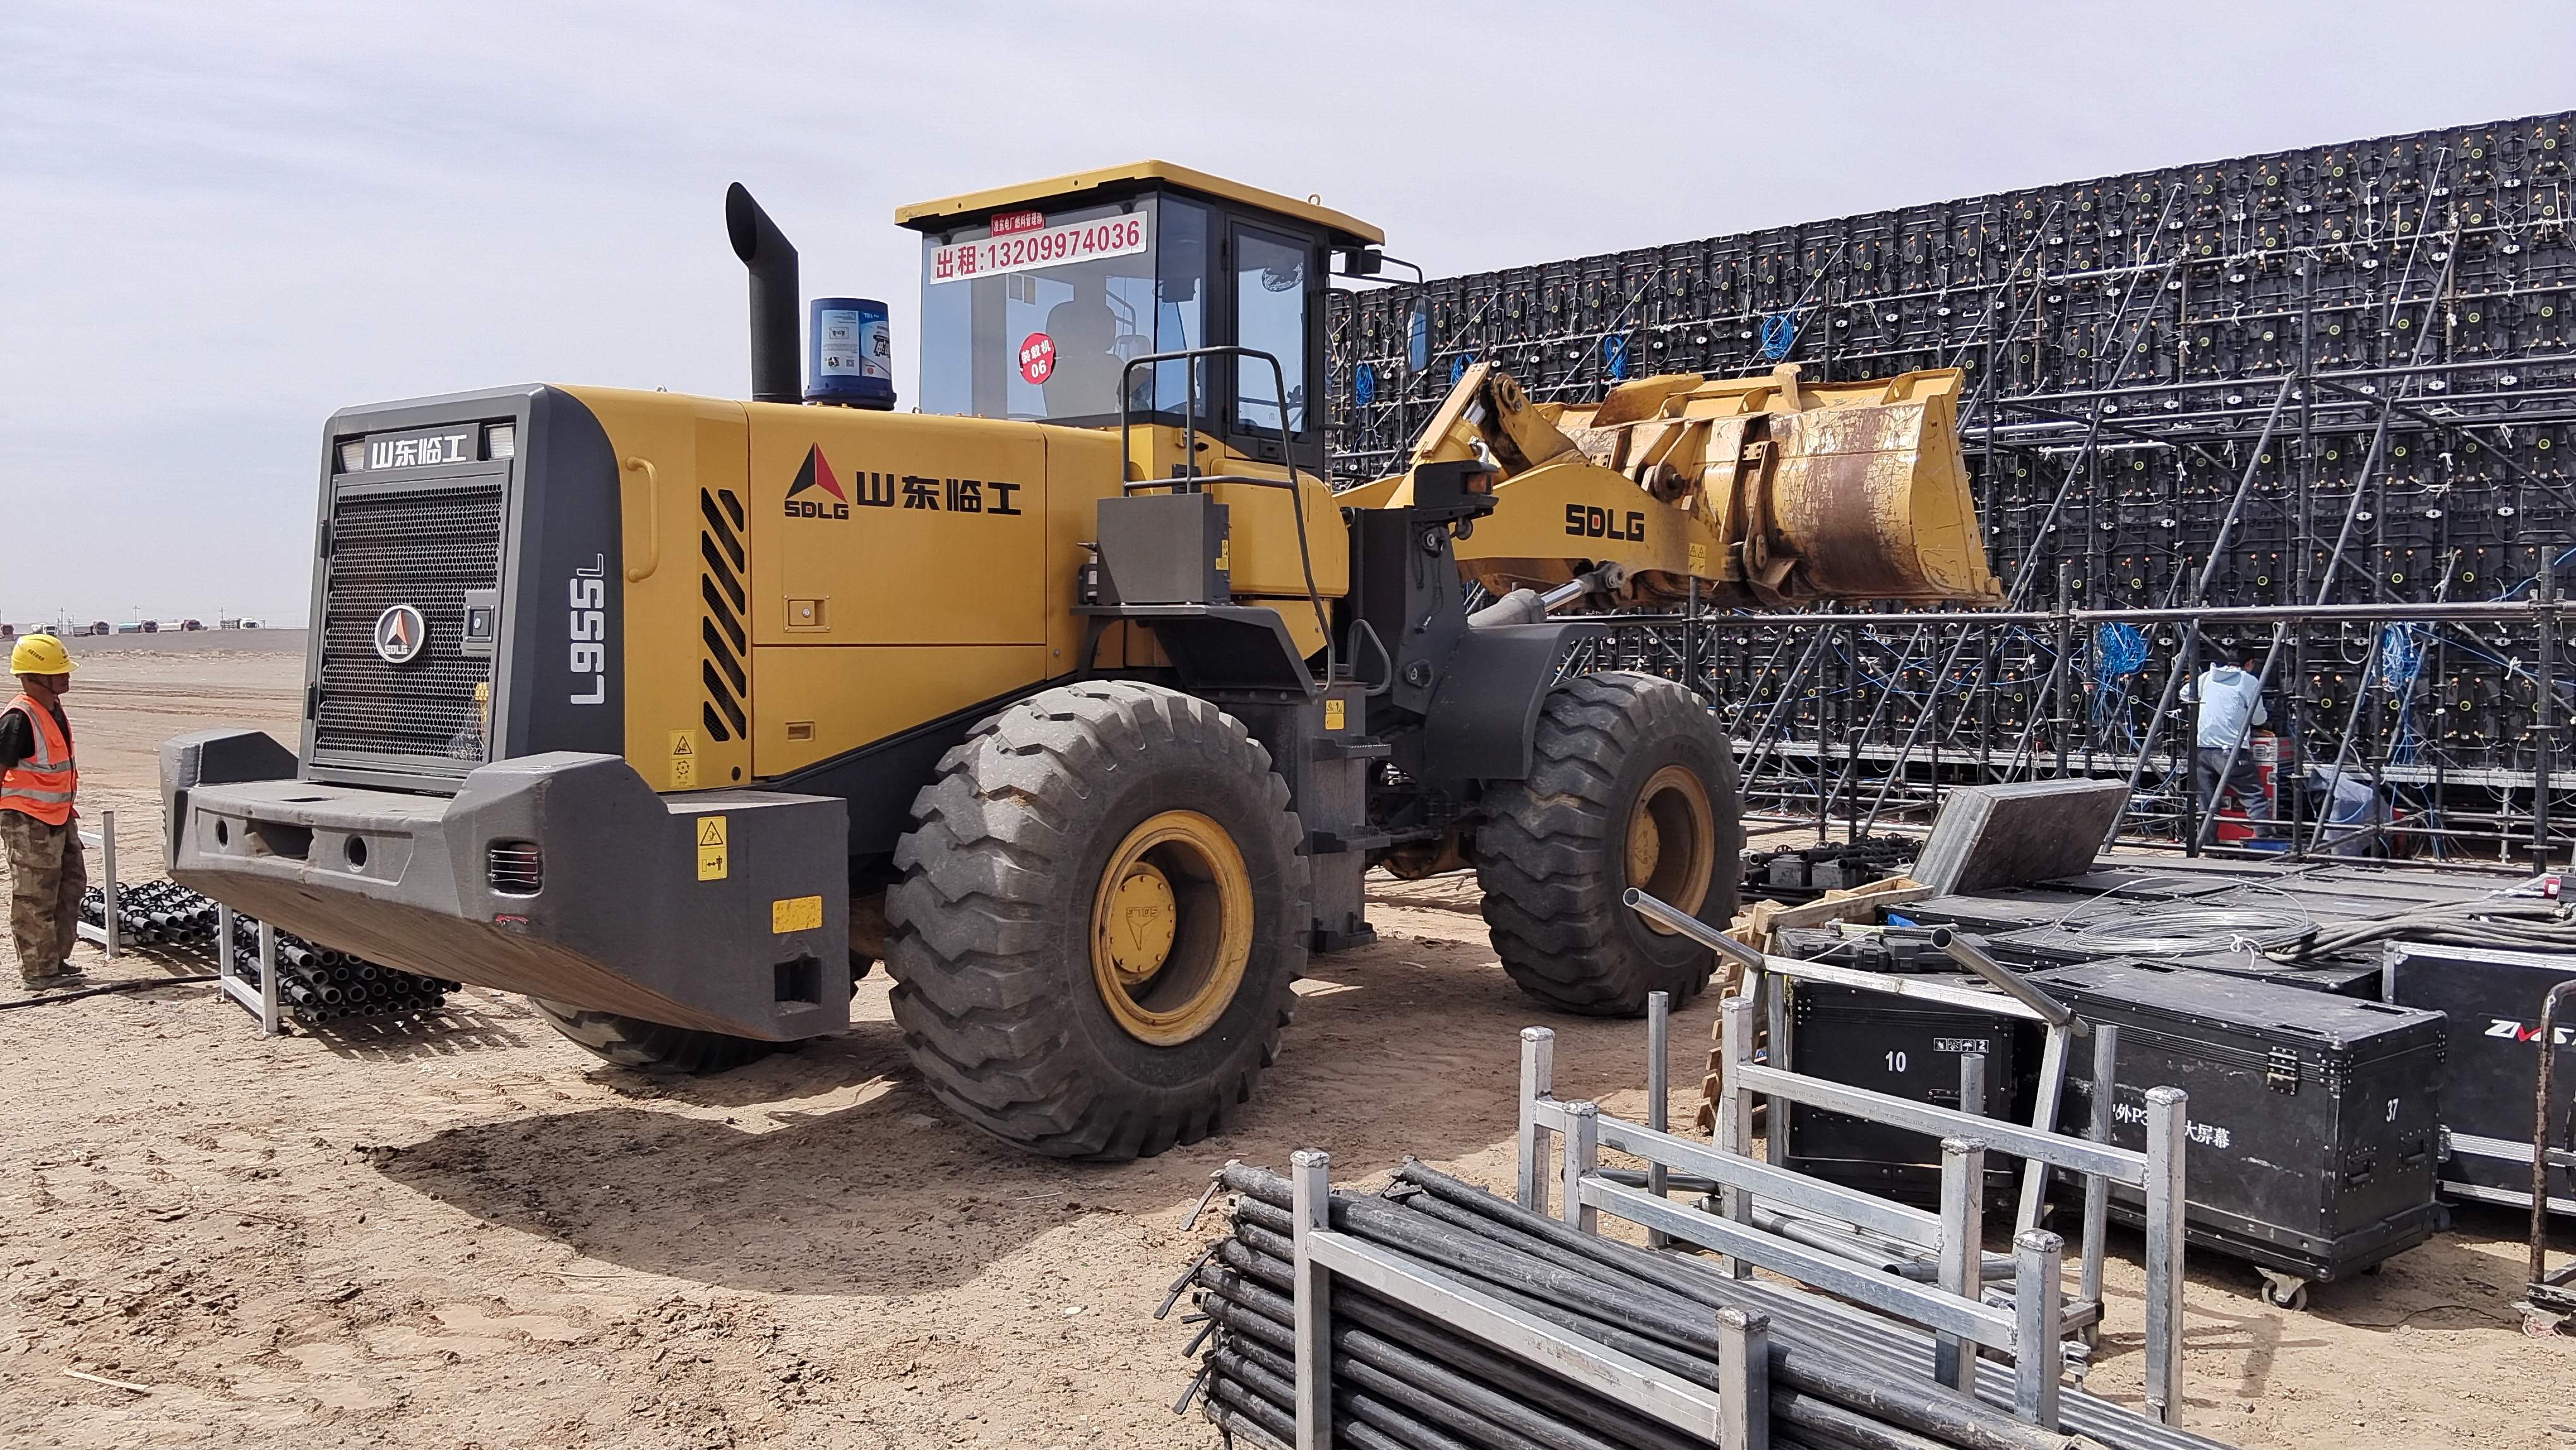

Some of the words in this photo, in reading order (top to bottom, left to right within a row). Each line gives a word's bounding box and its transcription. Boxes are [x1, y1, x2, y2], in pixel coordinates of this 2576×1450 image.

[1021, 339, 1051, 364] 装载机
[1031, 359, 1047, 378] 06
[371, 434, 467, 469] 山东临工
[856, 471, 1022, 515] 山东临工
[785, 500, 849, 520] SDLG
[1565, 503, 1645, 542] SDLG
[570, 553, 604, 704] L955L
[385, 645, 408, 655] SDLG
[1126, 906, 1157, 918] SDLG
[1885, 1051, 1906, 1072] 10
[2113, 1103, 2147, 1126] 外P3
[2386, 1098, 2399, 1122] 37
